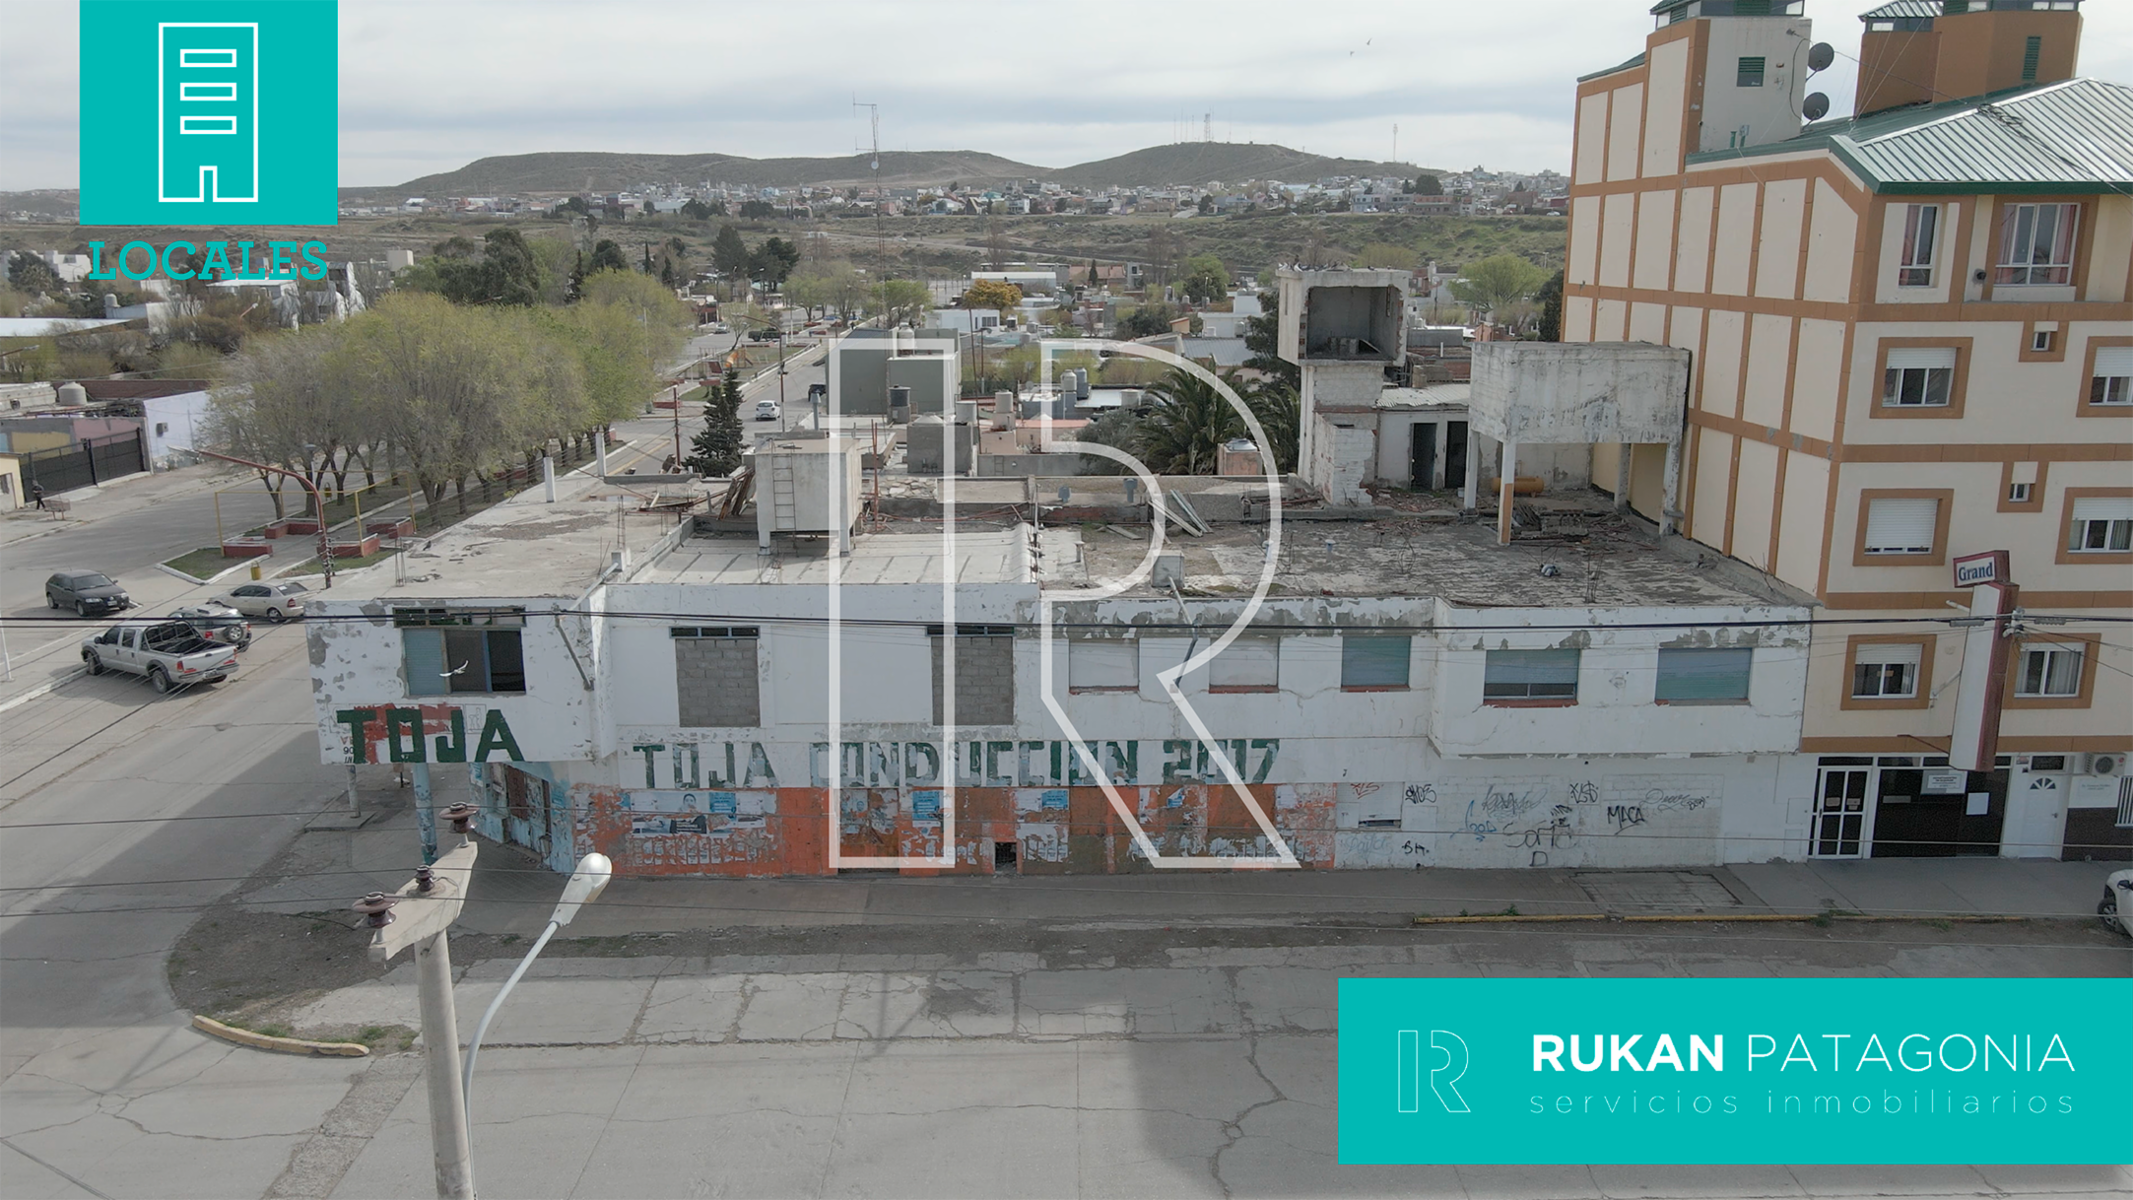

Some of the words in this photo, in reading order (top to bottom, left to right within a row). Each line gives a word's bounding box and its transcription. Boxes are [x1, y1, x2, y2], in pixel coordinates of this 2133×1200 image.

[1958, 561, 1994, 582] Grand
[336, 708, 524, 764] TOJA
[632, 741, 779, 788] TOJA
[810, 740, 1138, 787] CONDUCCION
